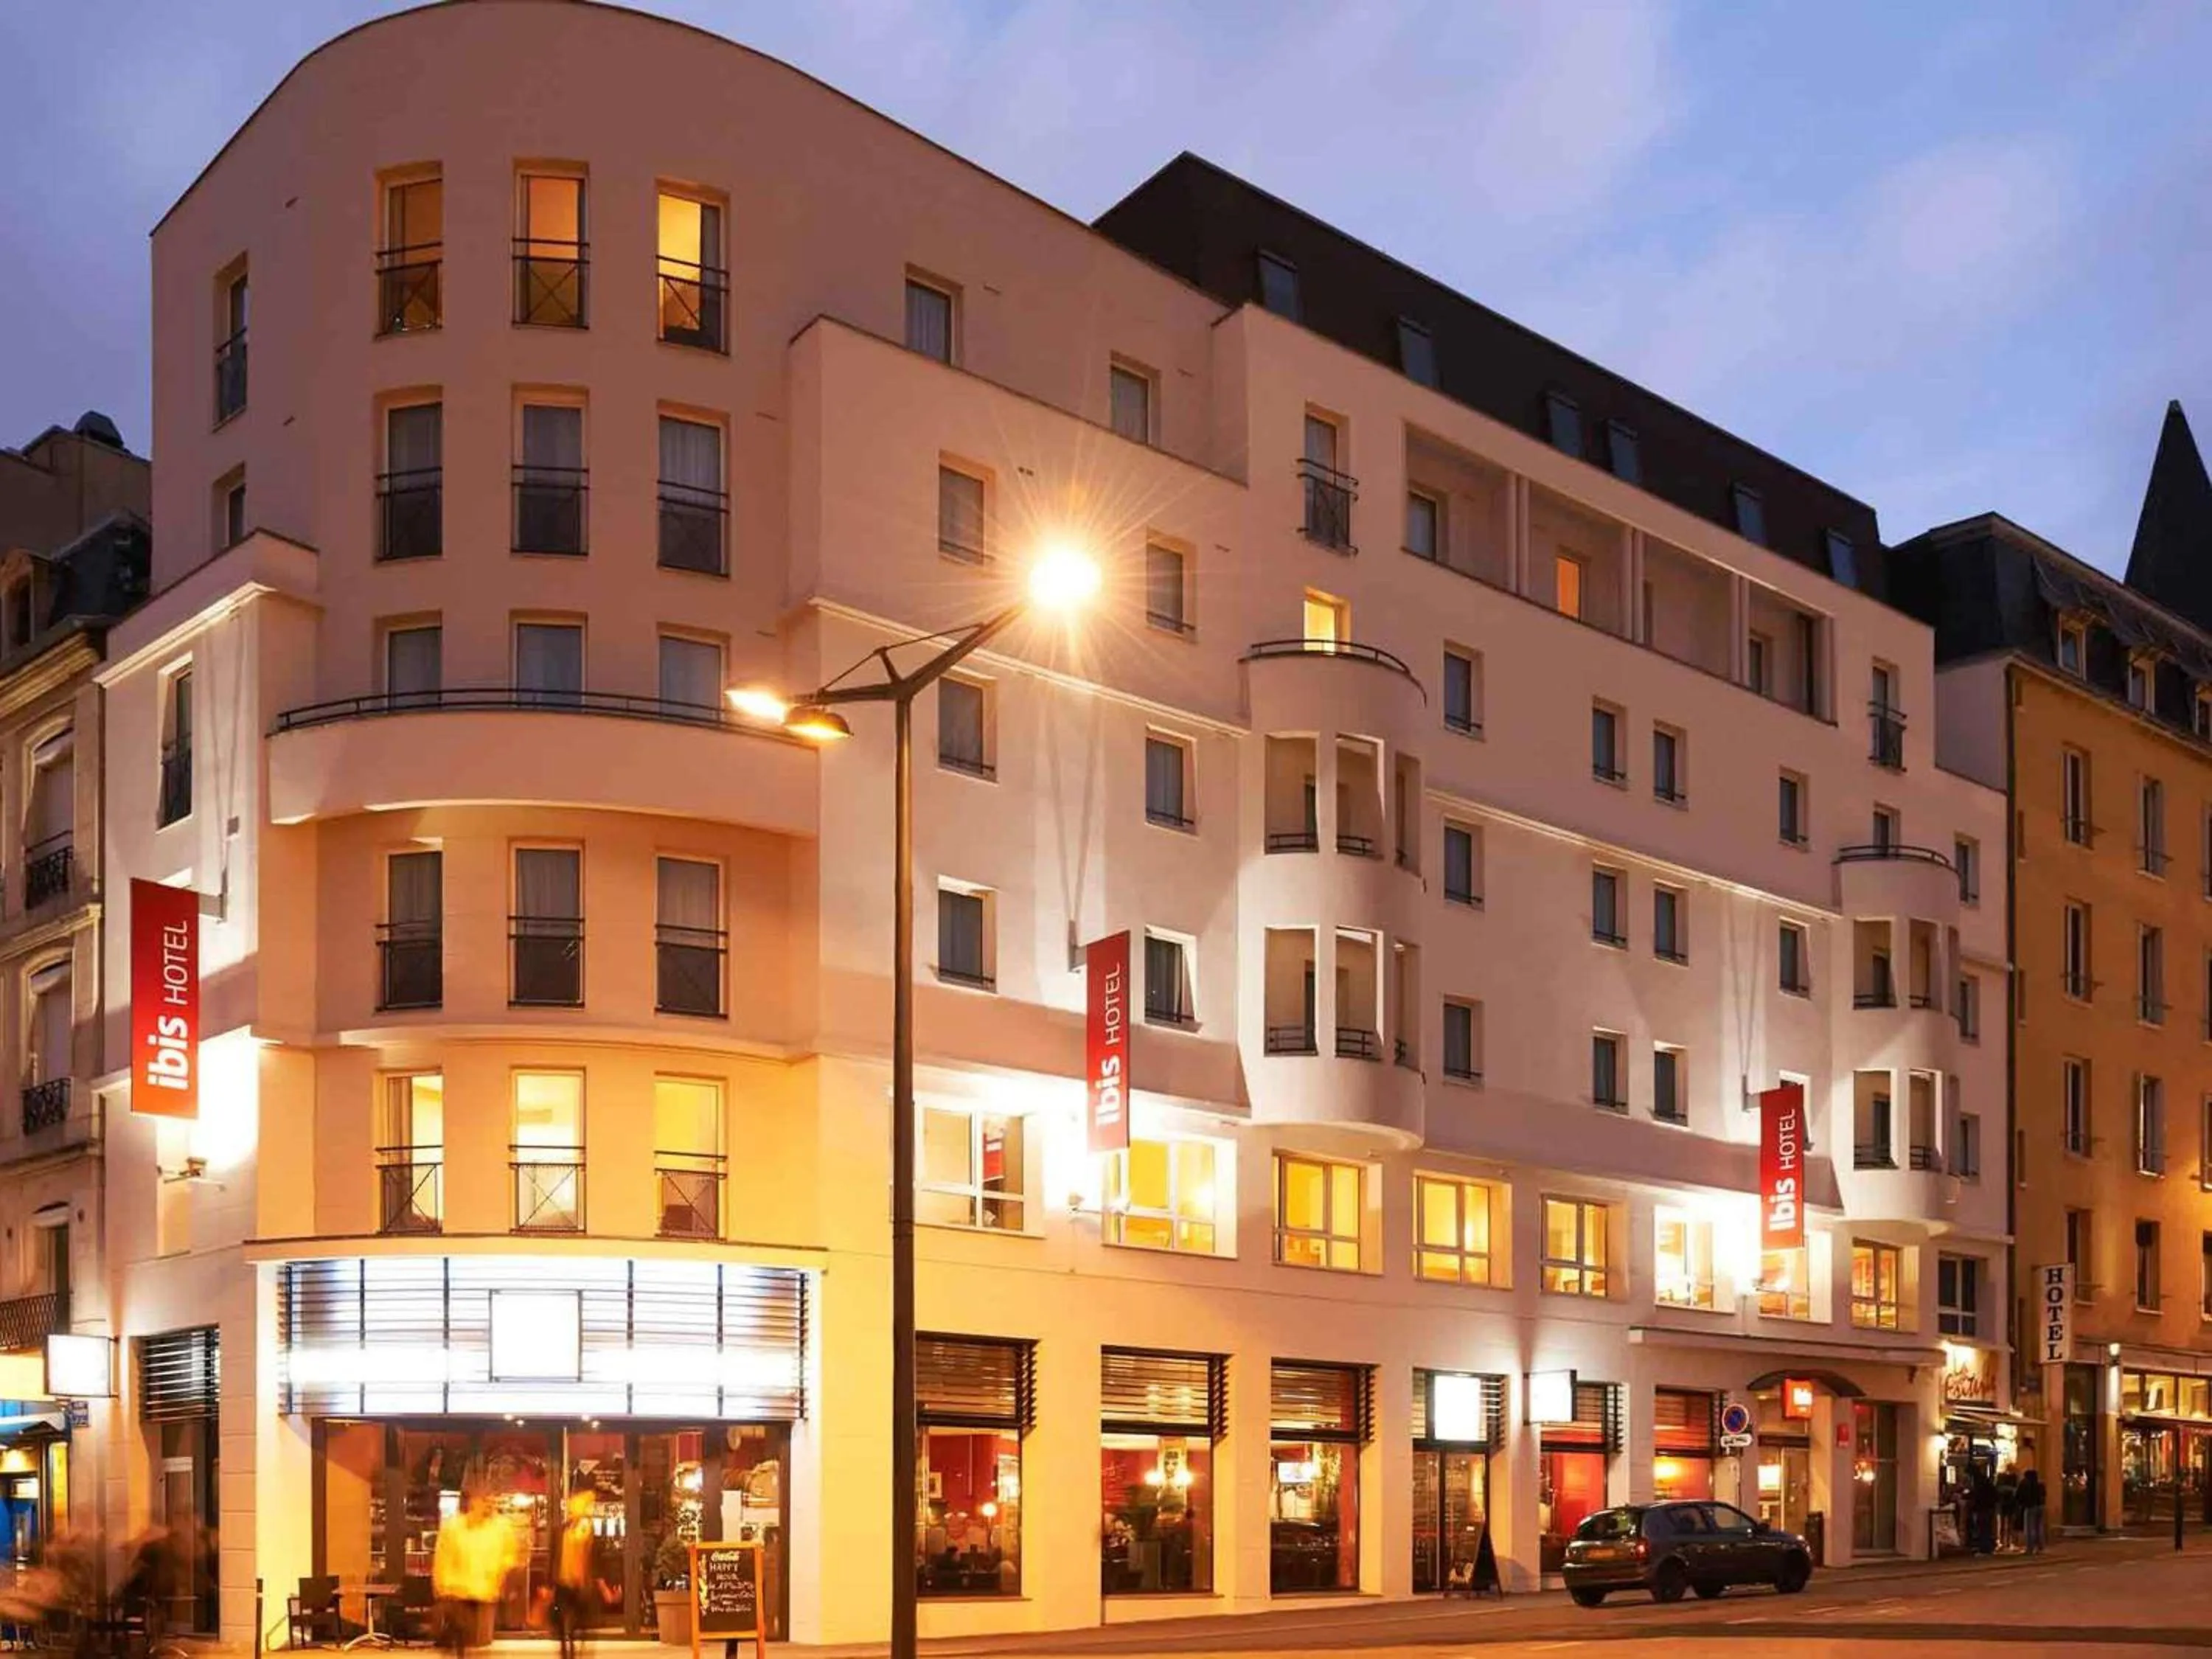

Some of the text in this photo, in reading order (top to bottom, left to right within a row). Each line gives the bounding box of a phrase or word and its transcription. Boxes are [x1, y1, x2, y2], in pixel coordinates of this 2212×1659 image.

[147, 920, 189, 1090] ibis HOTEL
[1095, 961, 1121, 1126] ibis HOTEL
[1770, 1109, 1796, 1231] ibis HOTEL
[2045, 1267, 2064, 1360] HOTEL
[709, 1562, 738, 1573] HAPPY
